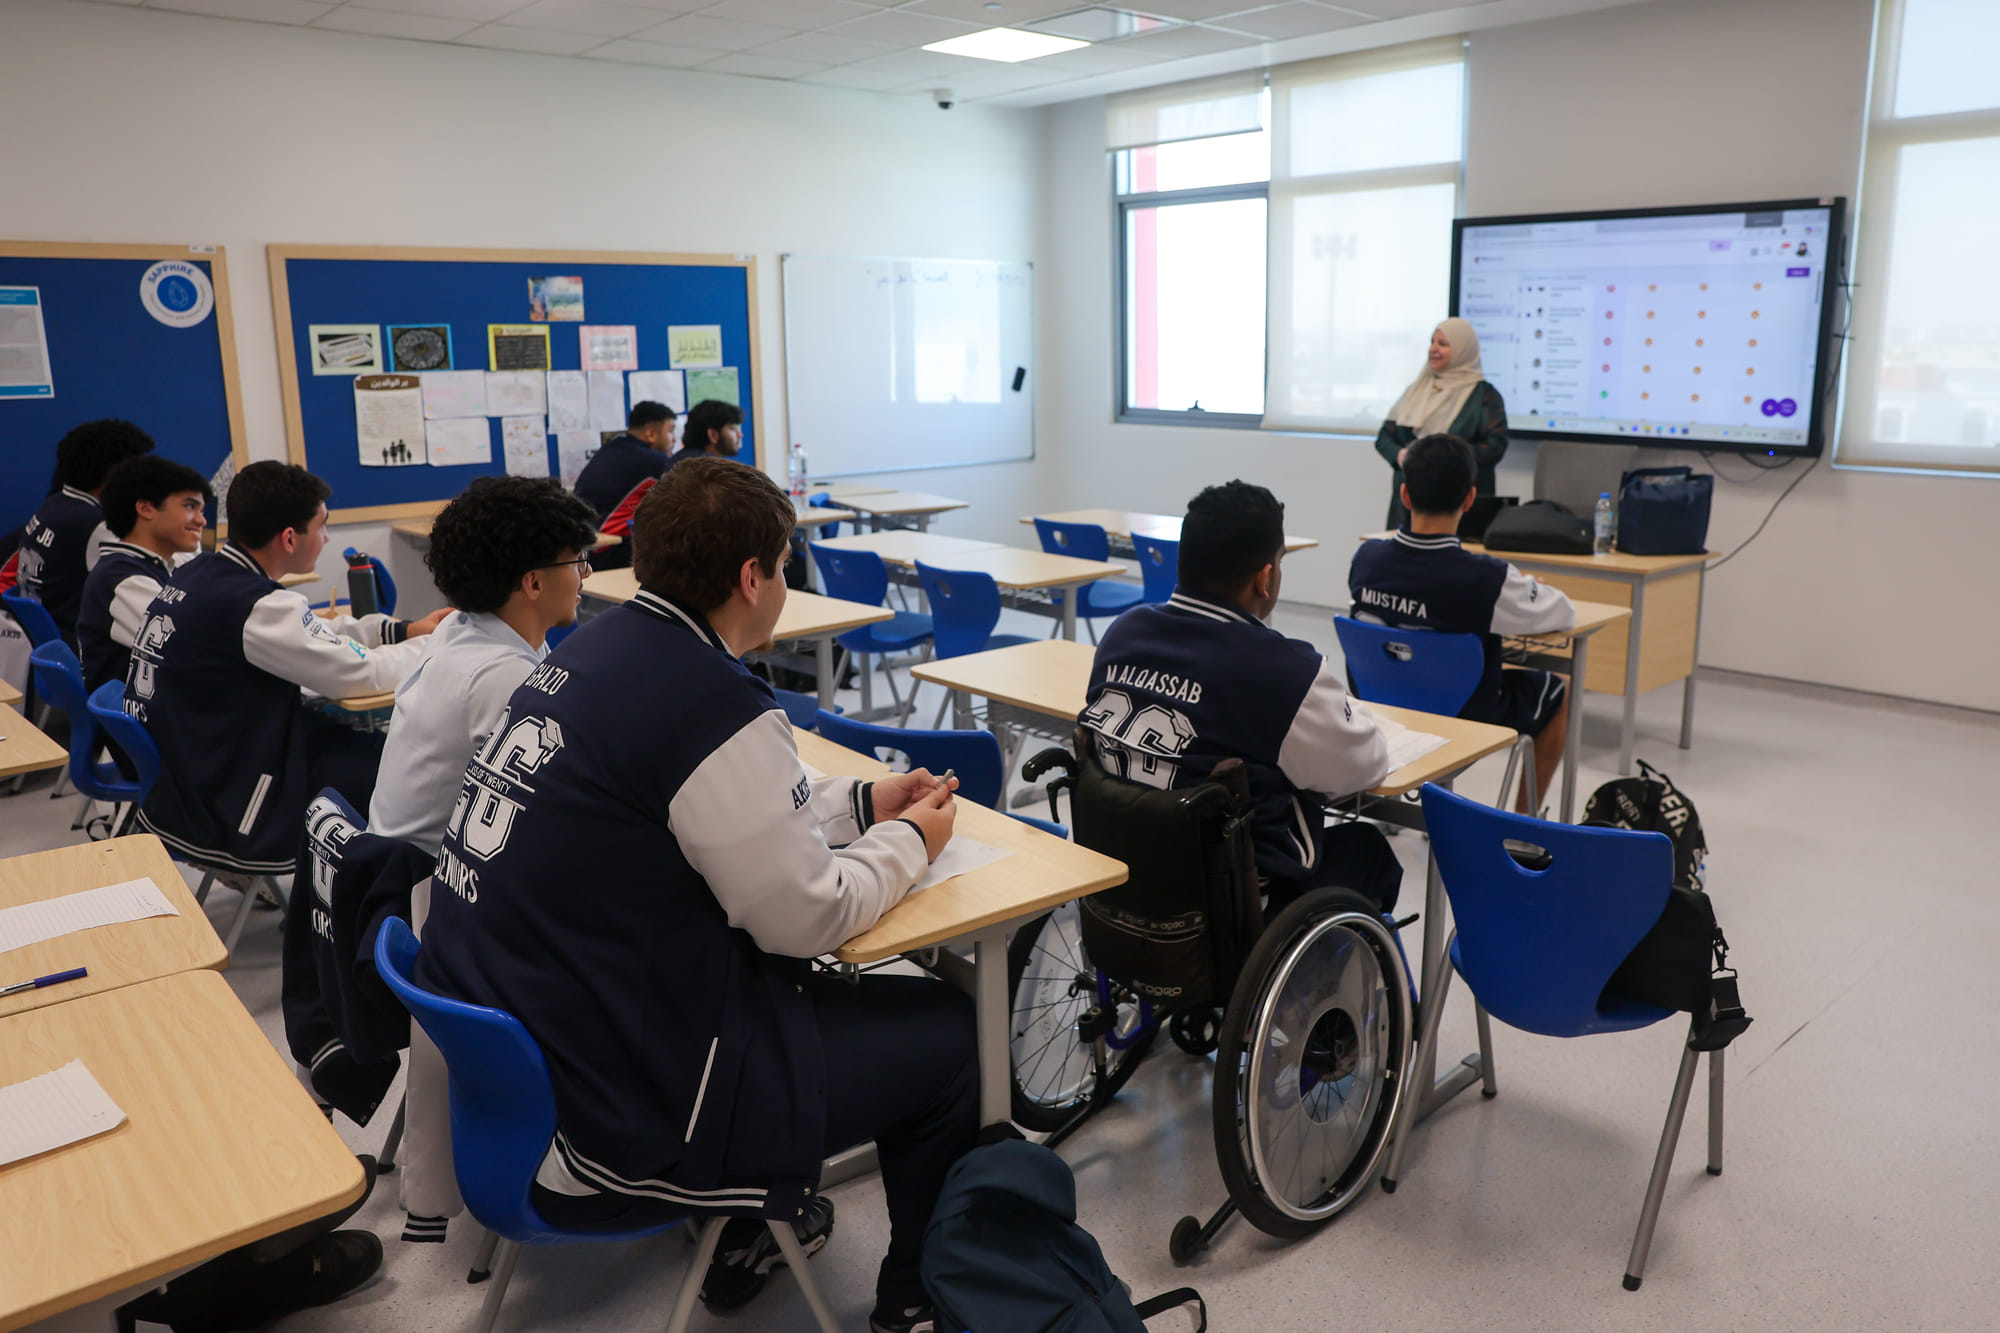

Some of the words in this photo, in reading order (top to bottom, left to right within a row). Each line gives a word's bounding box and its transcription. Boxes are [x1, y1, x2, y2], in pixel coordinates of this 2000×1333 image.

[147, 264, 194, 284] SAPPHIRE
[36, 527, 56, 548] JB
[1360, 587, 1428, 620] MUSTAFA
[1118, 664, 1203, 705] ALQASSAB
[1083, 687, 1182, 791] 26
[483, 772, 512, 795] TWENTY
[434, 843, 480, 904] SENIORS
